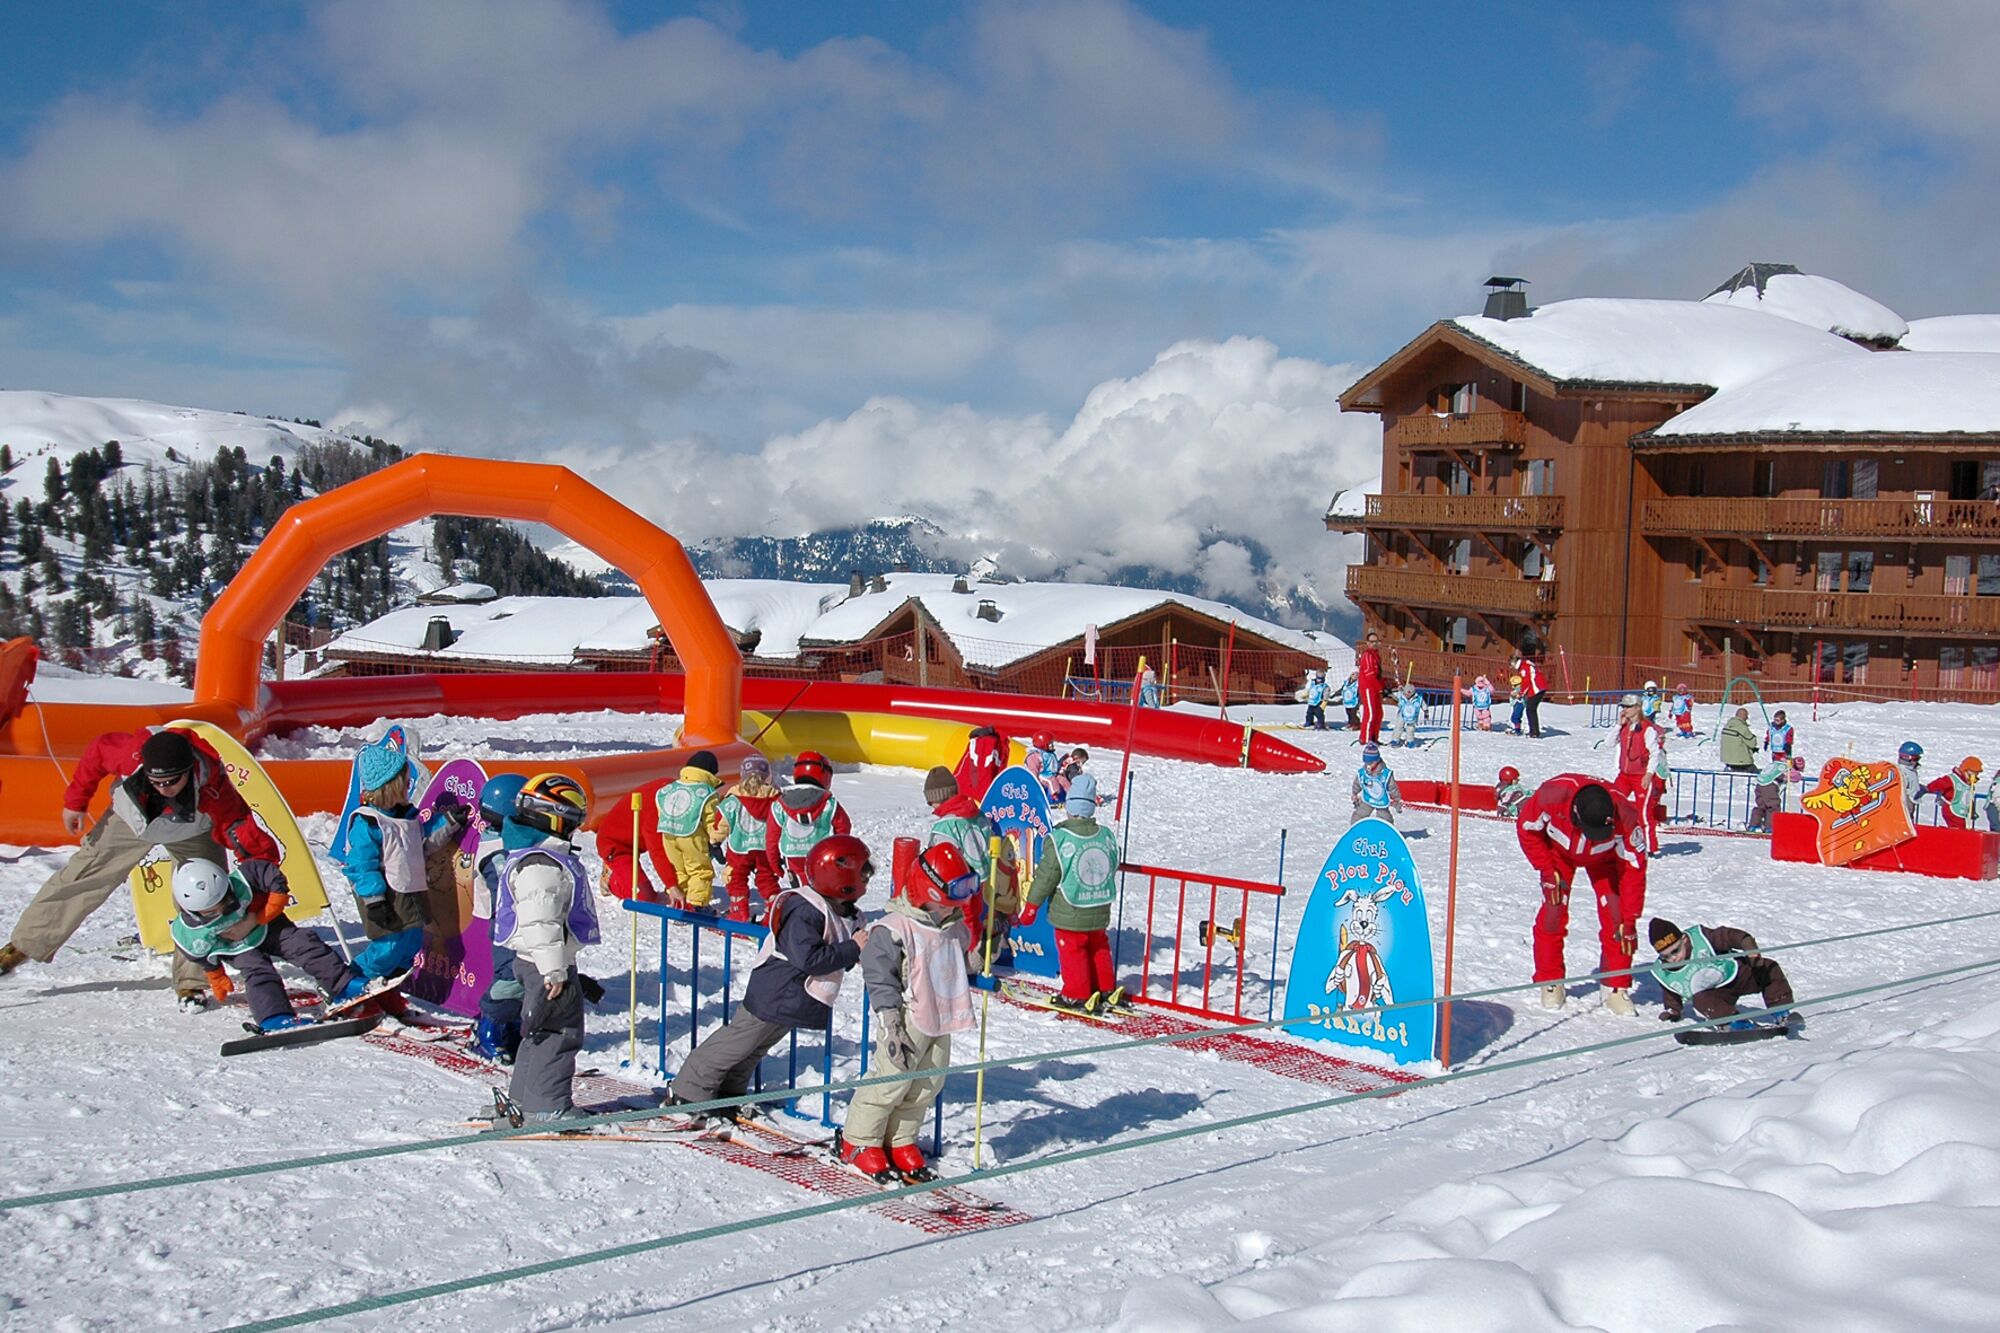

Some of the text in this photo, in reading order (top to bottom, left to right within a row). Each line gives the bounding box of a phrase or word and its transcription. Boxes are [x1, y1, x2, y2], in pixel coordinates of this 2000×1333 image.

[444, 775, 475, 799] Club
[1001, 782, 1029, 800] Club
[465, 802, 487, 834] Pio
[1019, 802, 1048, 838] Piou
[1352, 837, 1388, 859] Club
[1325, 861, 1413, 906] Piou Piou
